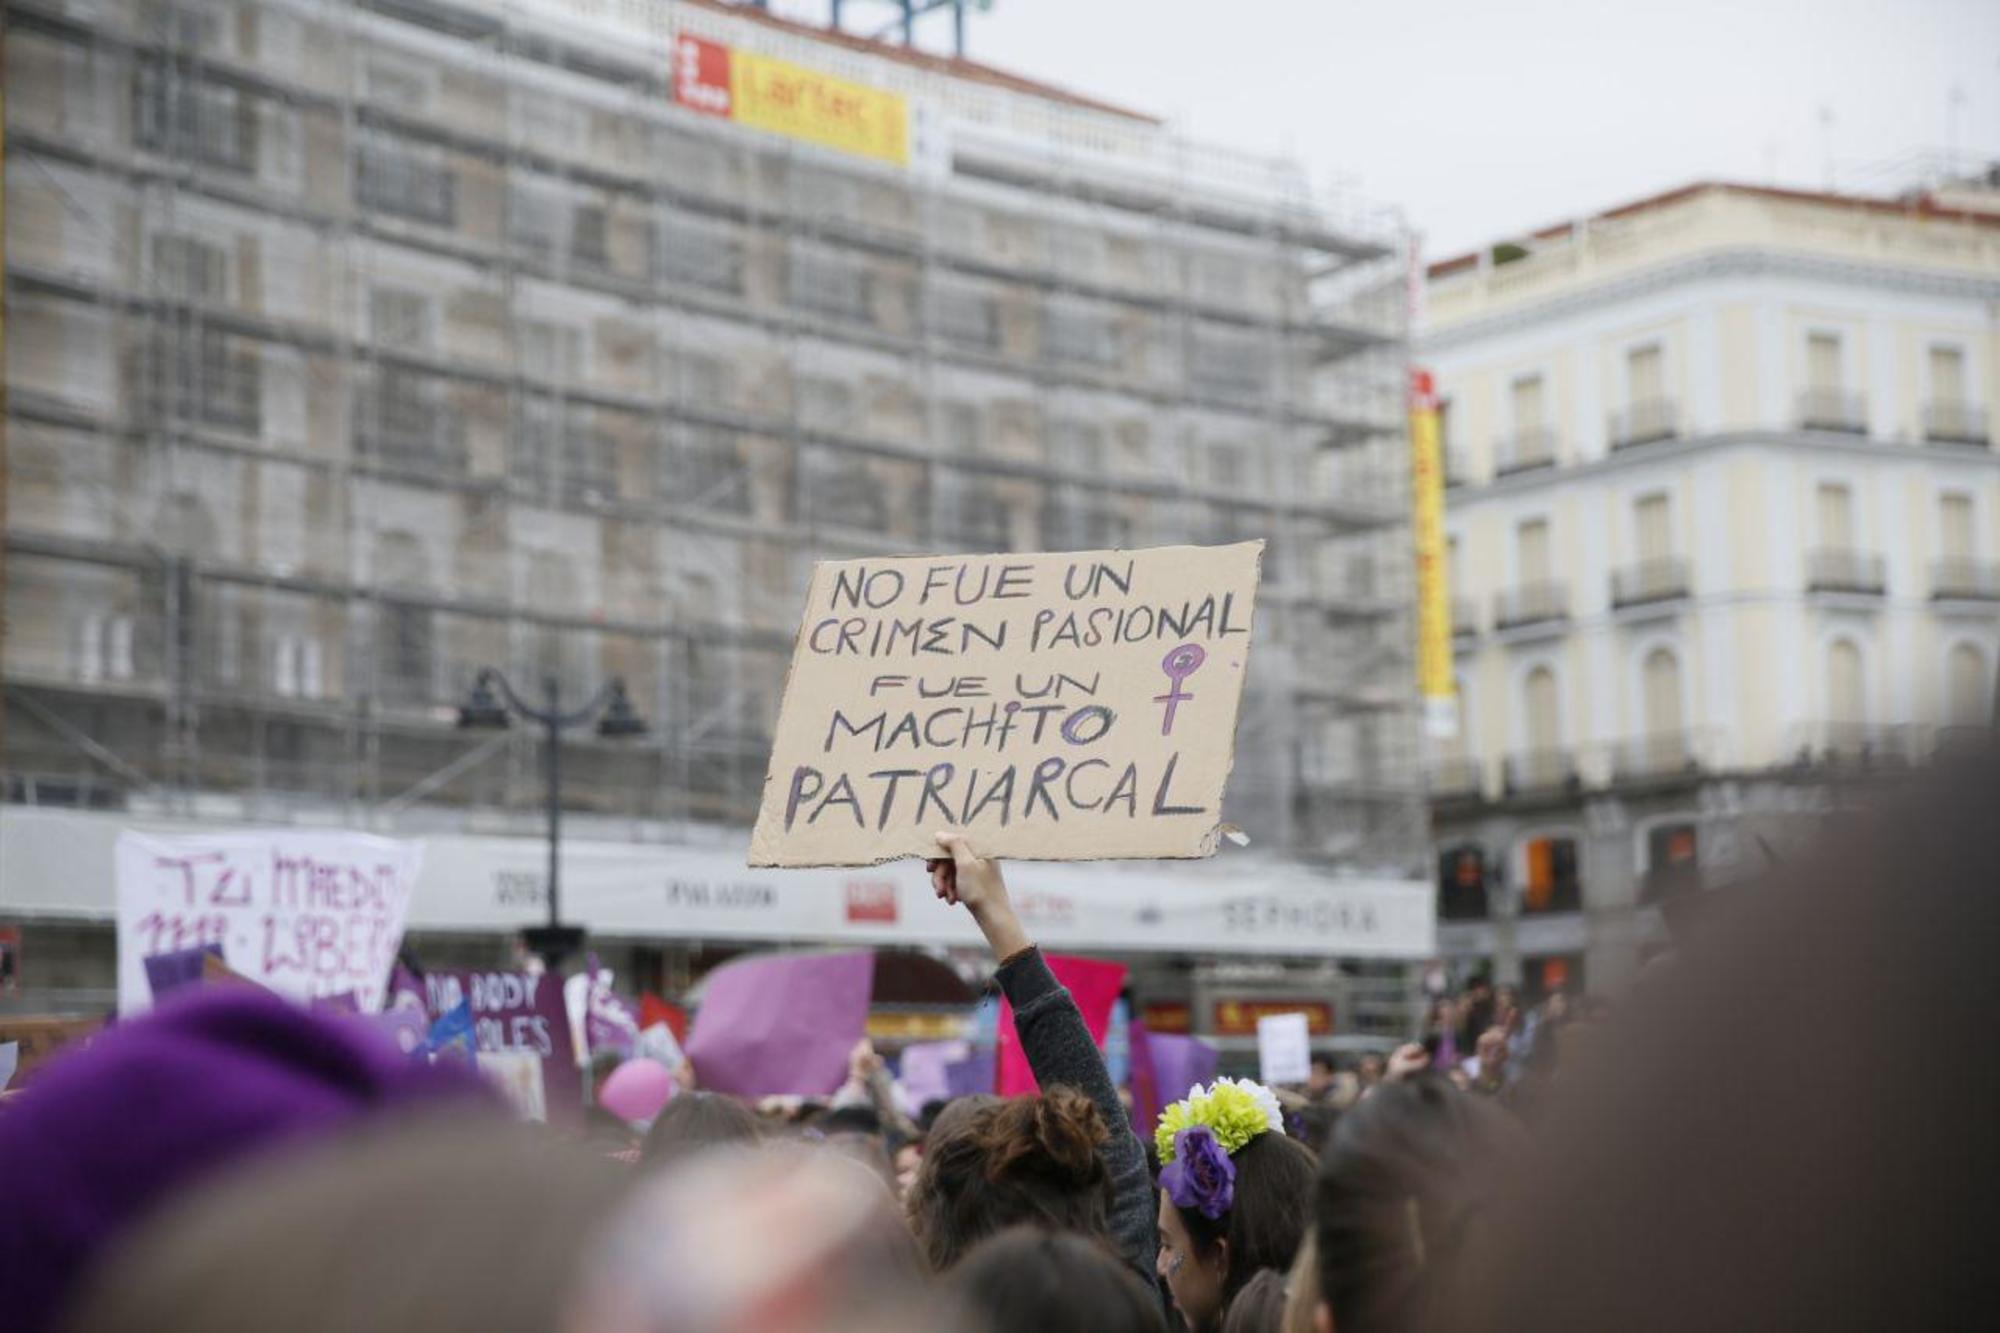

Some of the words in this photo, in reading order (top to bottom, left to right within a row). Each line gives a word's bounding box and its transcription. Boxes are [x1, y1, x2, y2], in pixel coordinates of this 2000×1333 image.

[831, 567, 904, 610] NO
[920, 564, 1034, 606] FUE
[1064, 559, 1134, 601] UN
[809, 617, 1008, 657] CRIMEN
[1031, 592, 1248, 653] PASIONAL
[870, 674, 992, 698] FUE
[1015, 672, 1101, 698] UN
[783, 752, 1206, 833] PATRIARCAL
